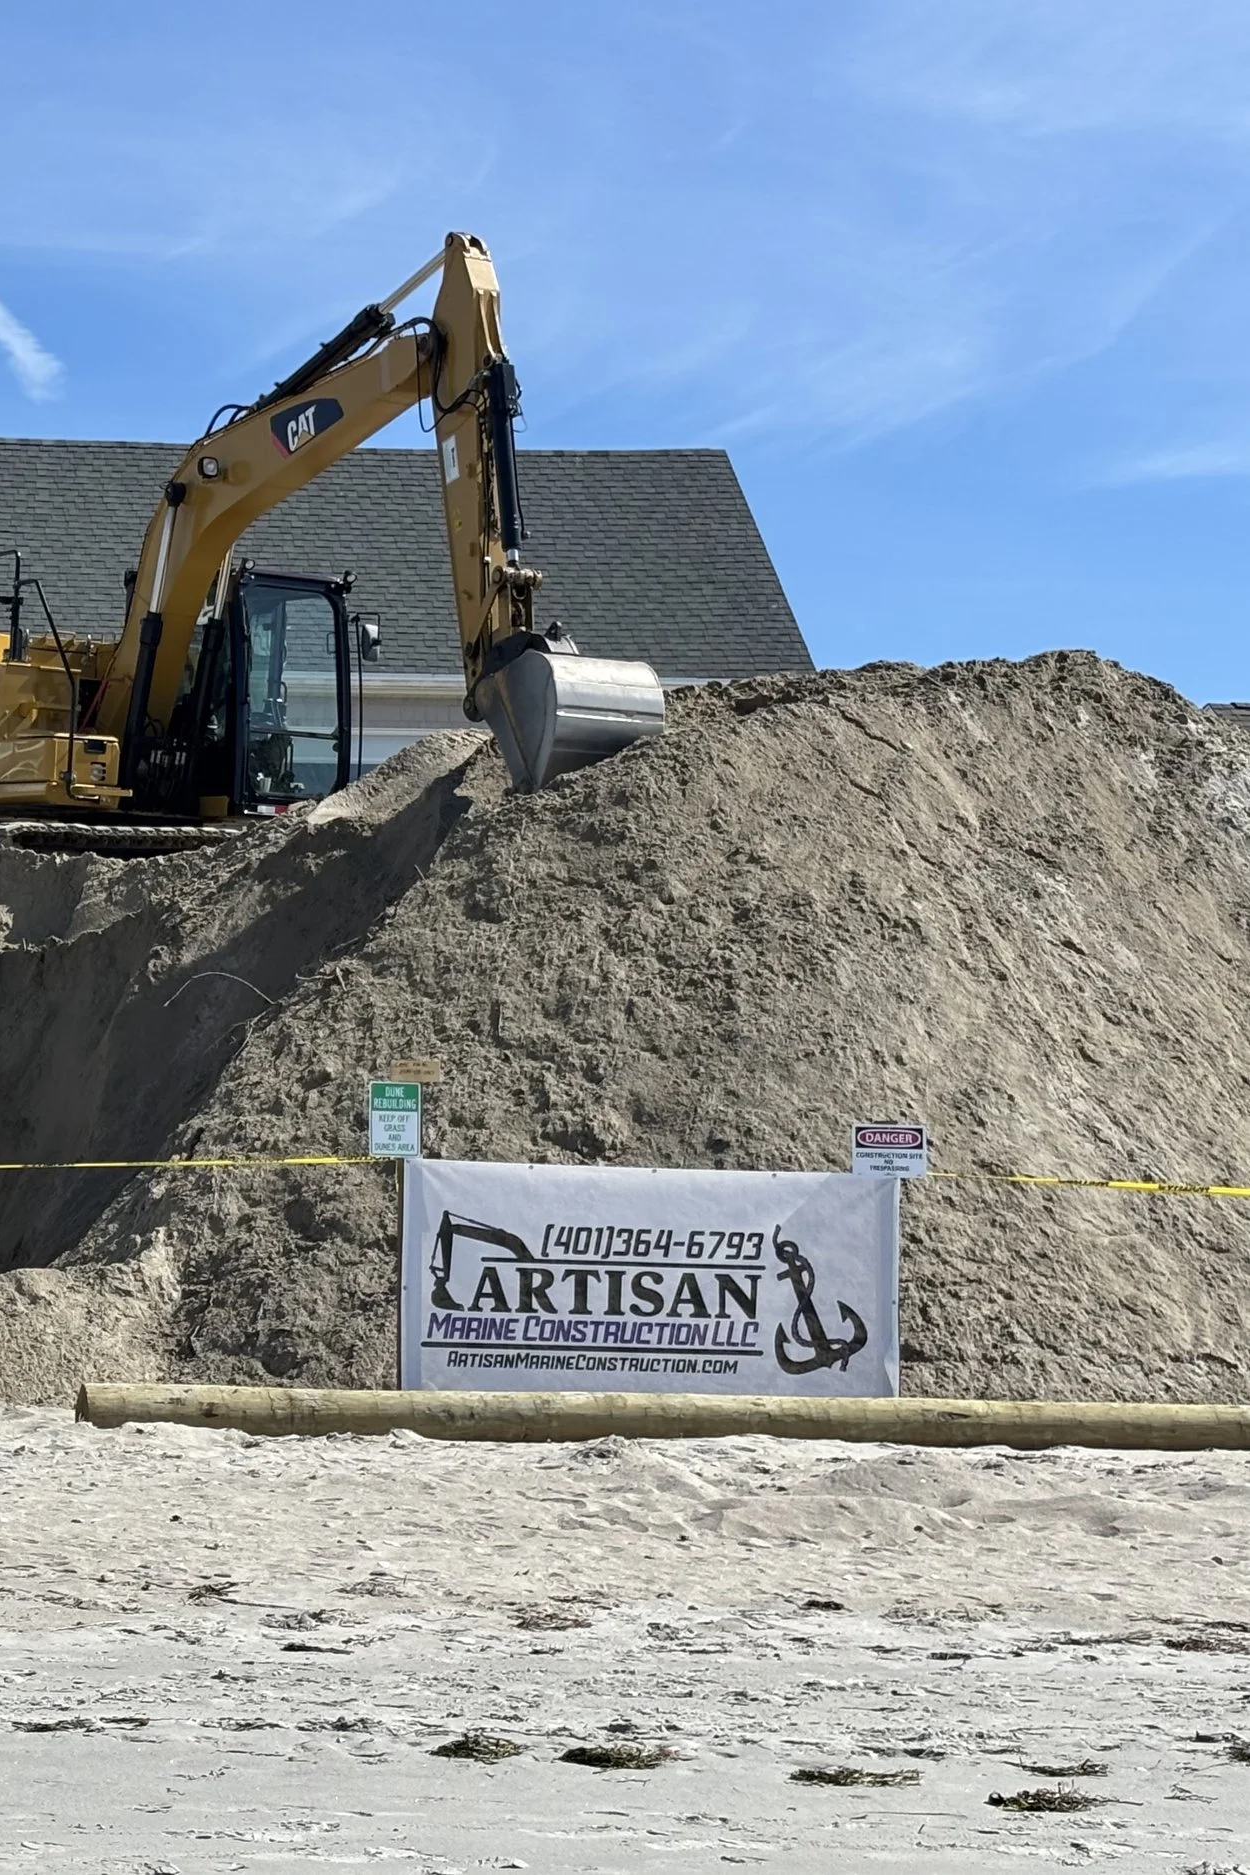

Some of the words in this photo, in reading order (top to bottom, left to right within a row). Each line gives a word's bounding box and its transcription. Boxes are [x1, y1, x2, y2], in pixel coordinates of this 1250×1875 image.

[287, 405, 317, 452] CAT
[385, 1086, 405, 1098] DUNE
[373, 1098, 417, 1109] REBUILDING
[378, 1114, 396, 1123] KEEP
[397, 1114, 409, 1123] OFF
[383, 1123, 406, 1133] GRASS
[388, 1133, 402, 1142] AND
[865, 1132, 913, 1144] DANGER
[374, 1143, 396, 1152] DUNES
[397, 1143, 415, 1152] AREA
[855, 1151, 908, 1159] CONSTRUCTION
[869, 1164, 910, 1172] TRESPASSING
[541, 1224, 764, 1261] (401)364-6793
[467, 1266, 762, 1320] ARTISAN
[711, 1320, 760, 1348] LLC
